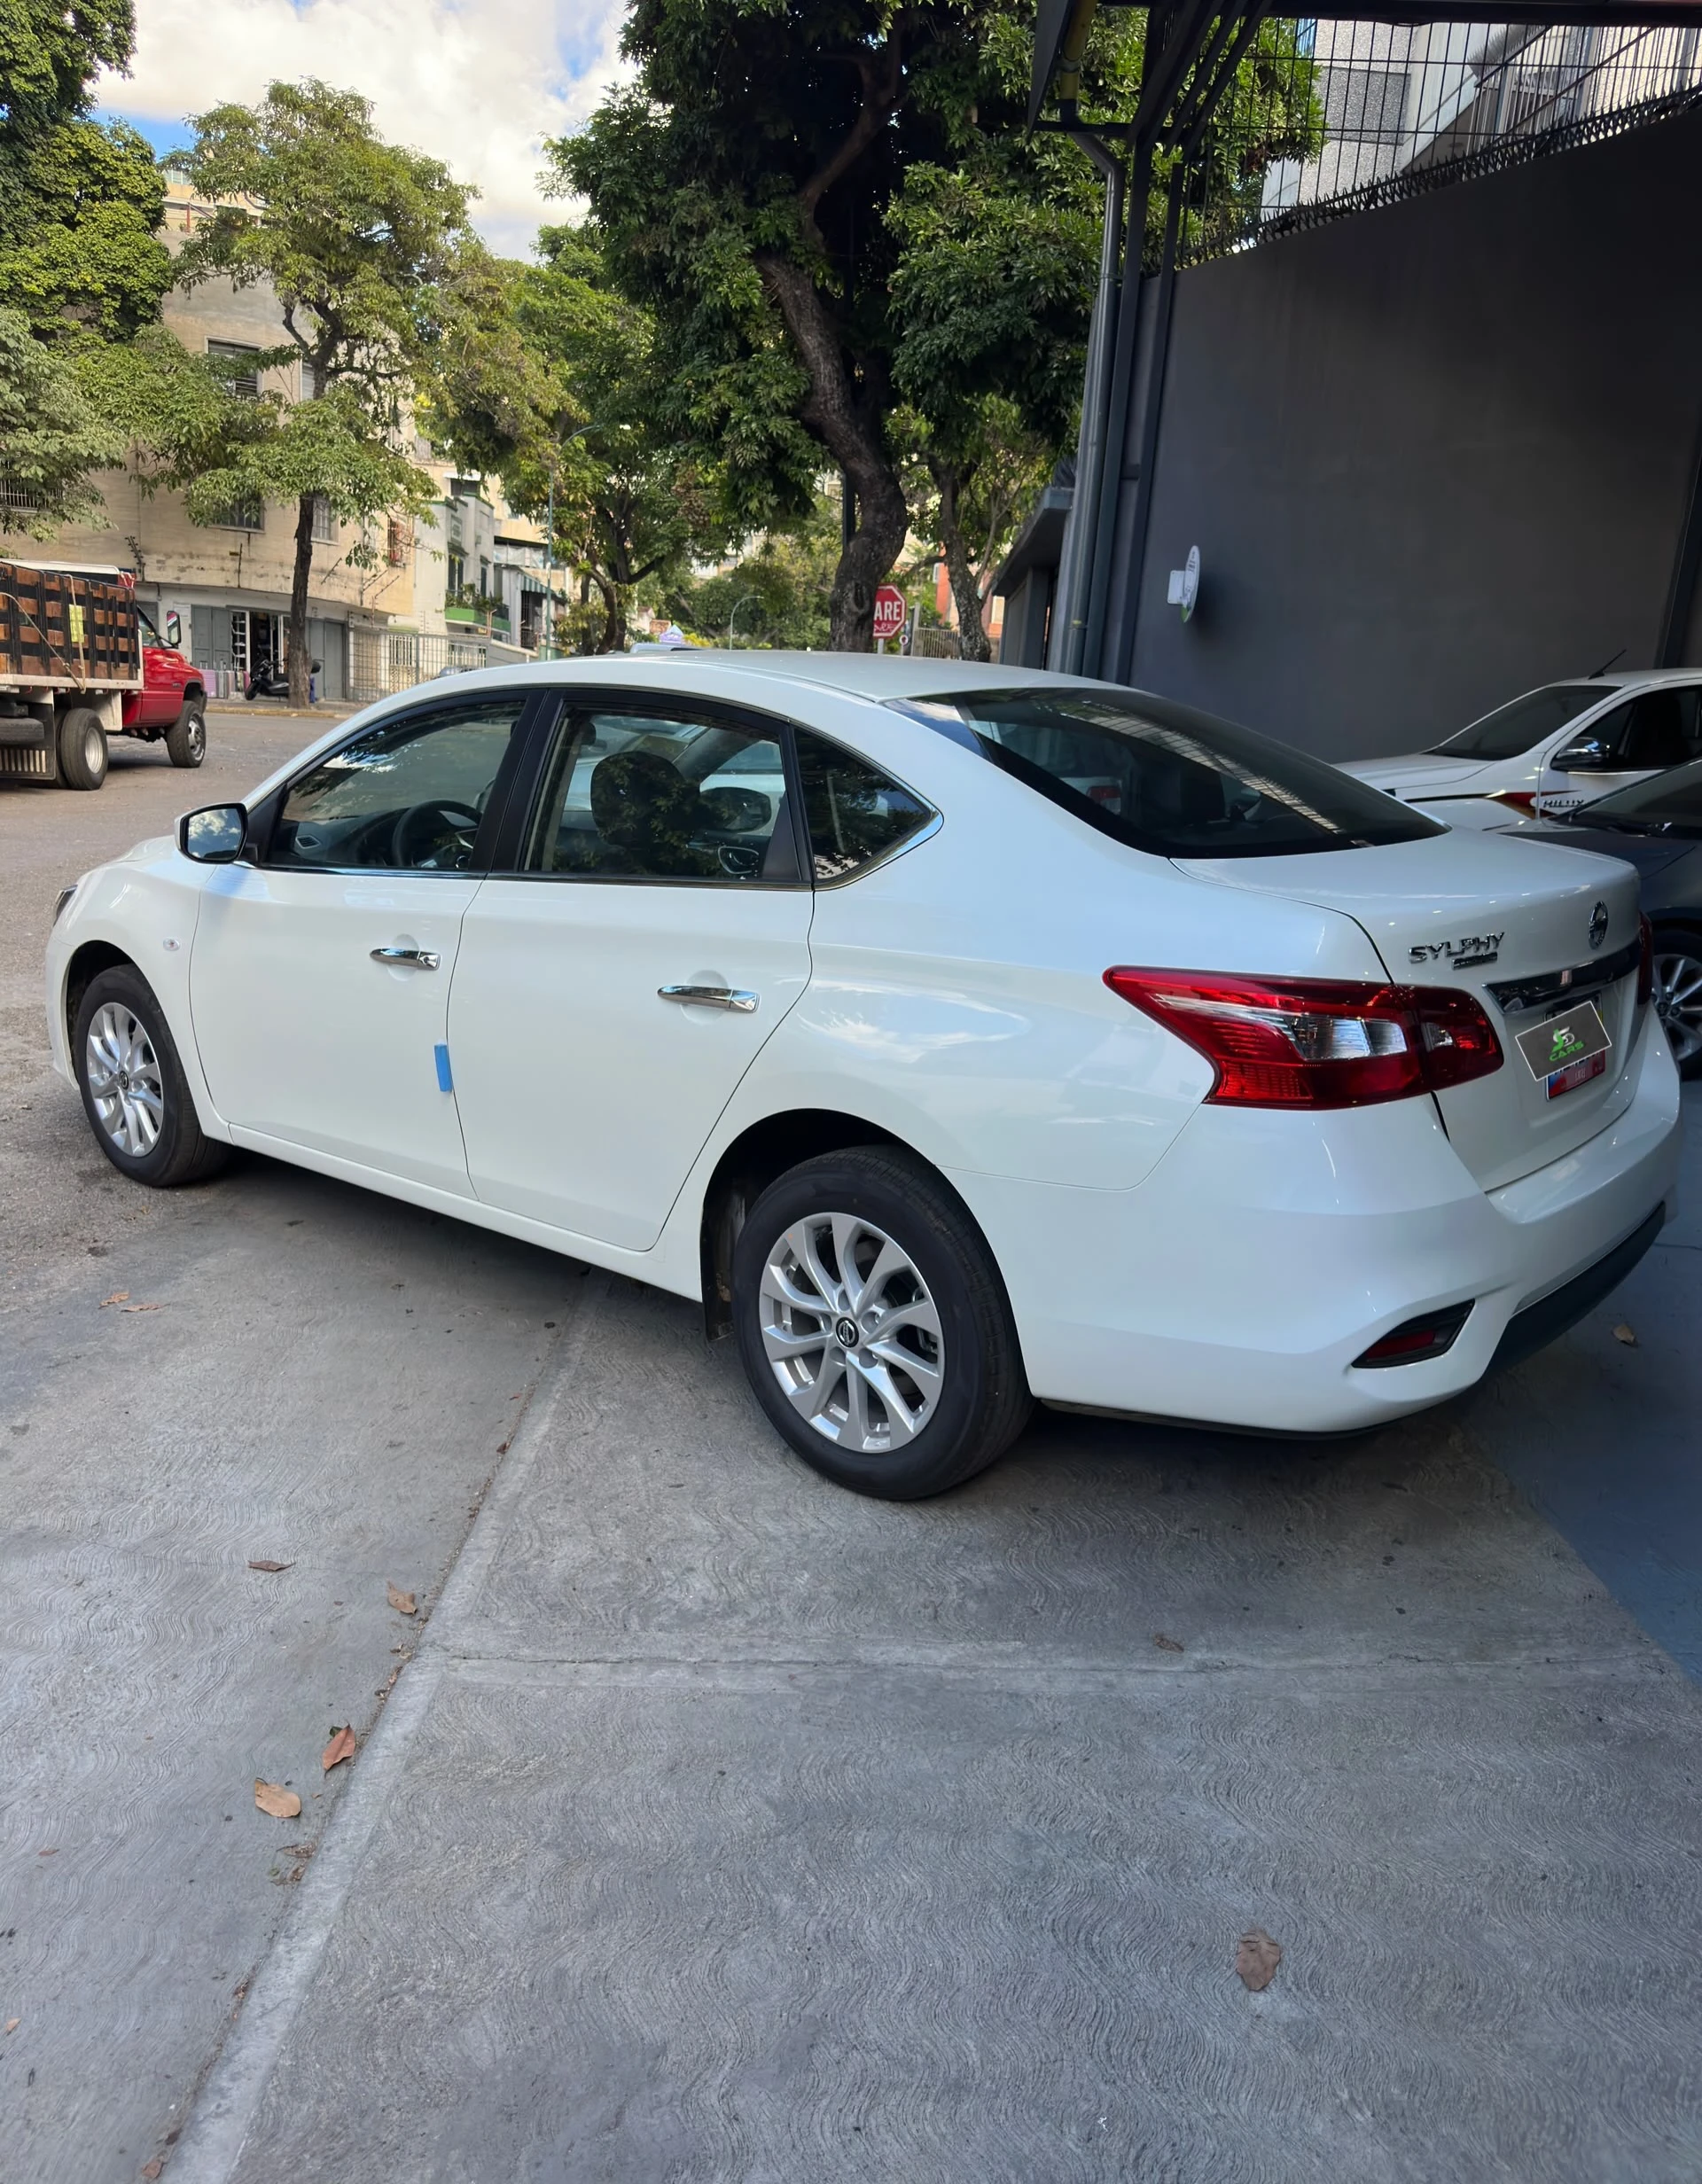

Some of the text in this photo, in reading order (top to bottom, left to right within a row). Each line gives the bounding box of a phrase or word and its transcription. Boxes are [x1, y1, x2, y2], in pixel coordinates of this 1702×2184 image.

[874, 601, 901, 620] ARE
[1543, 800, 1584, 808] HILUX
[1408, 932, 1504, 964] SYLPHY
